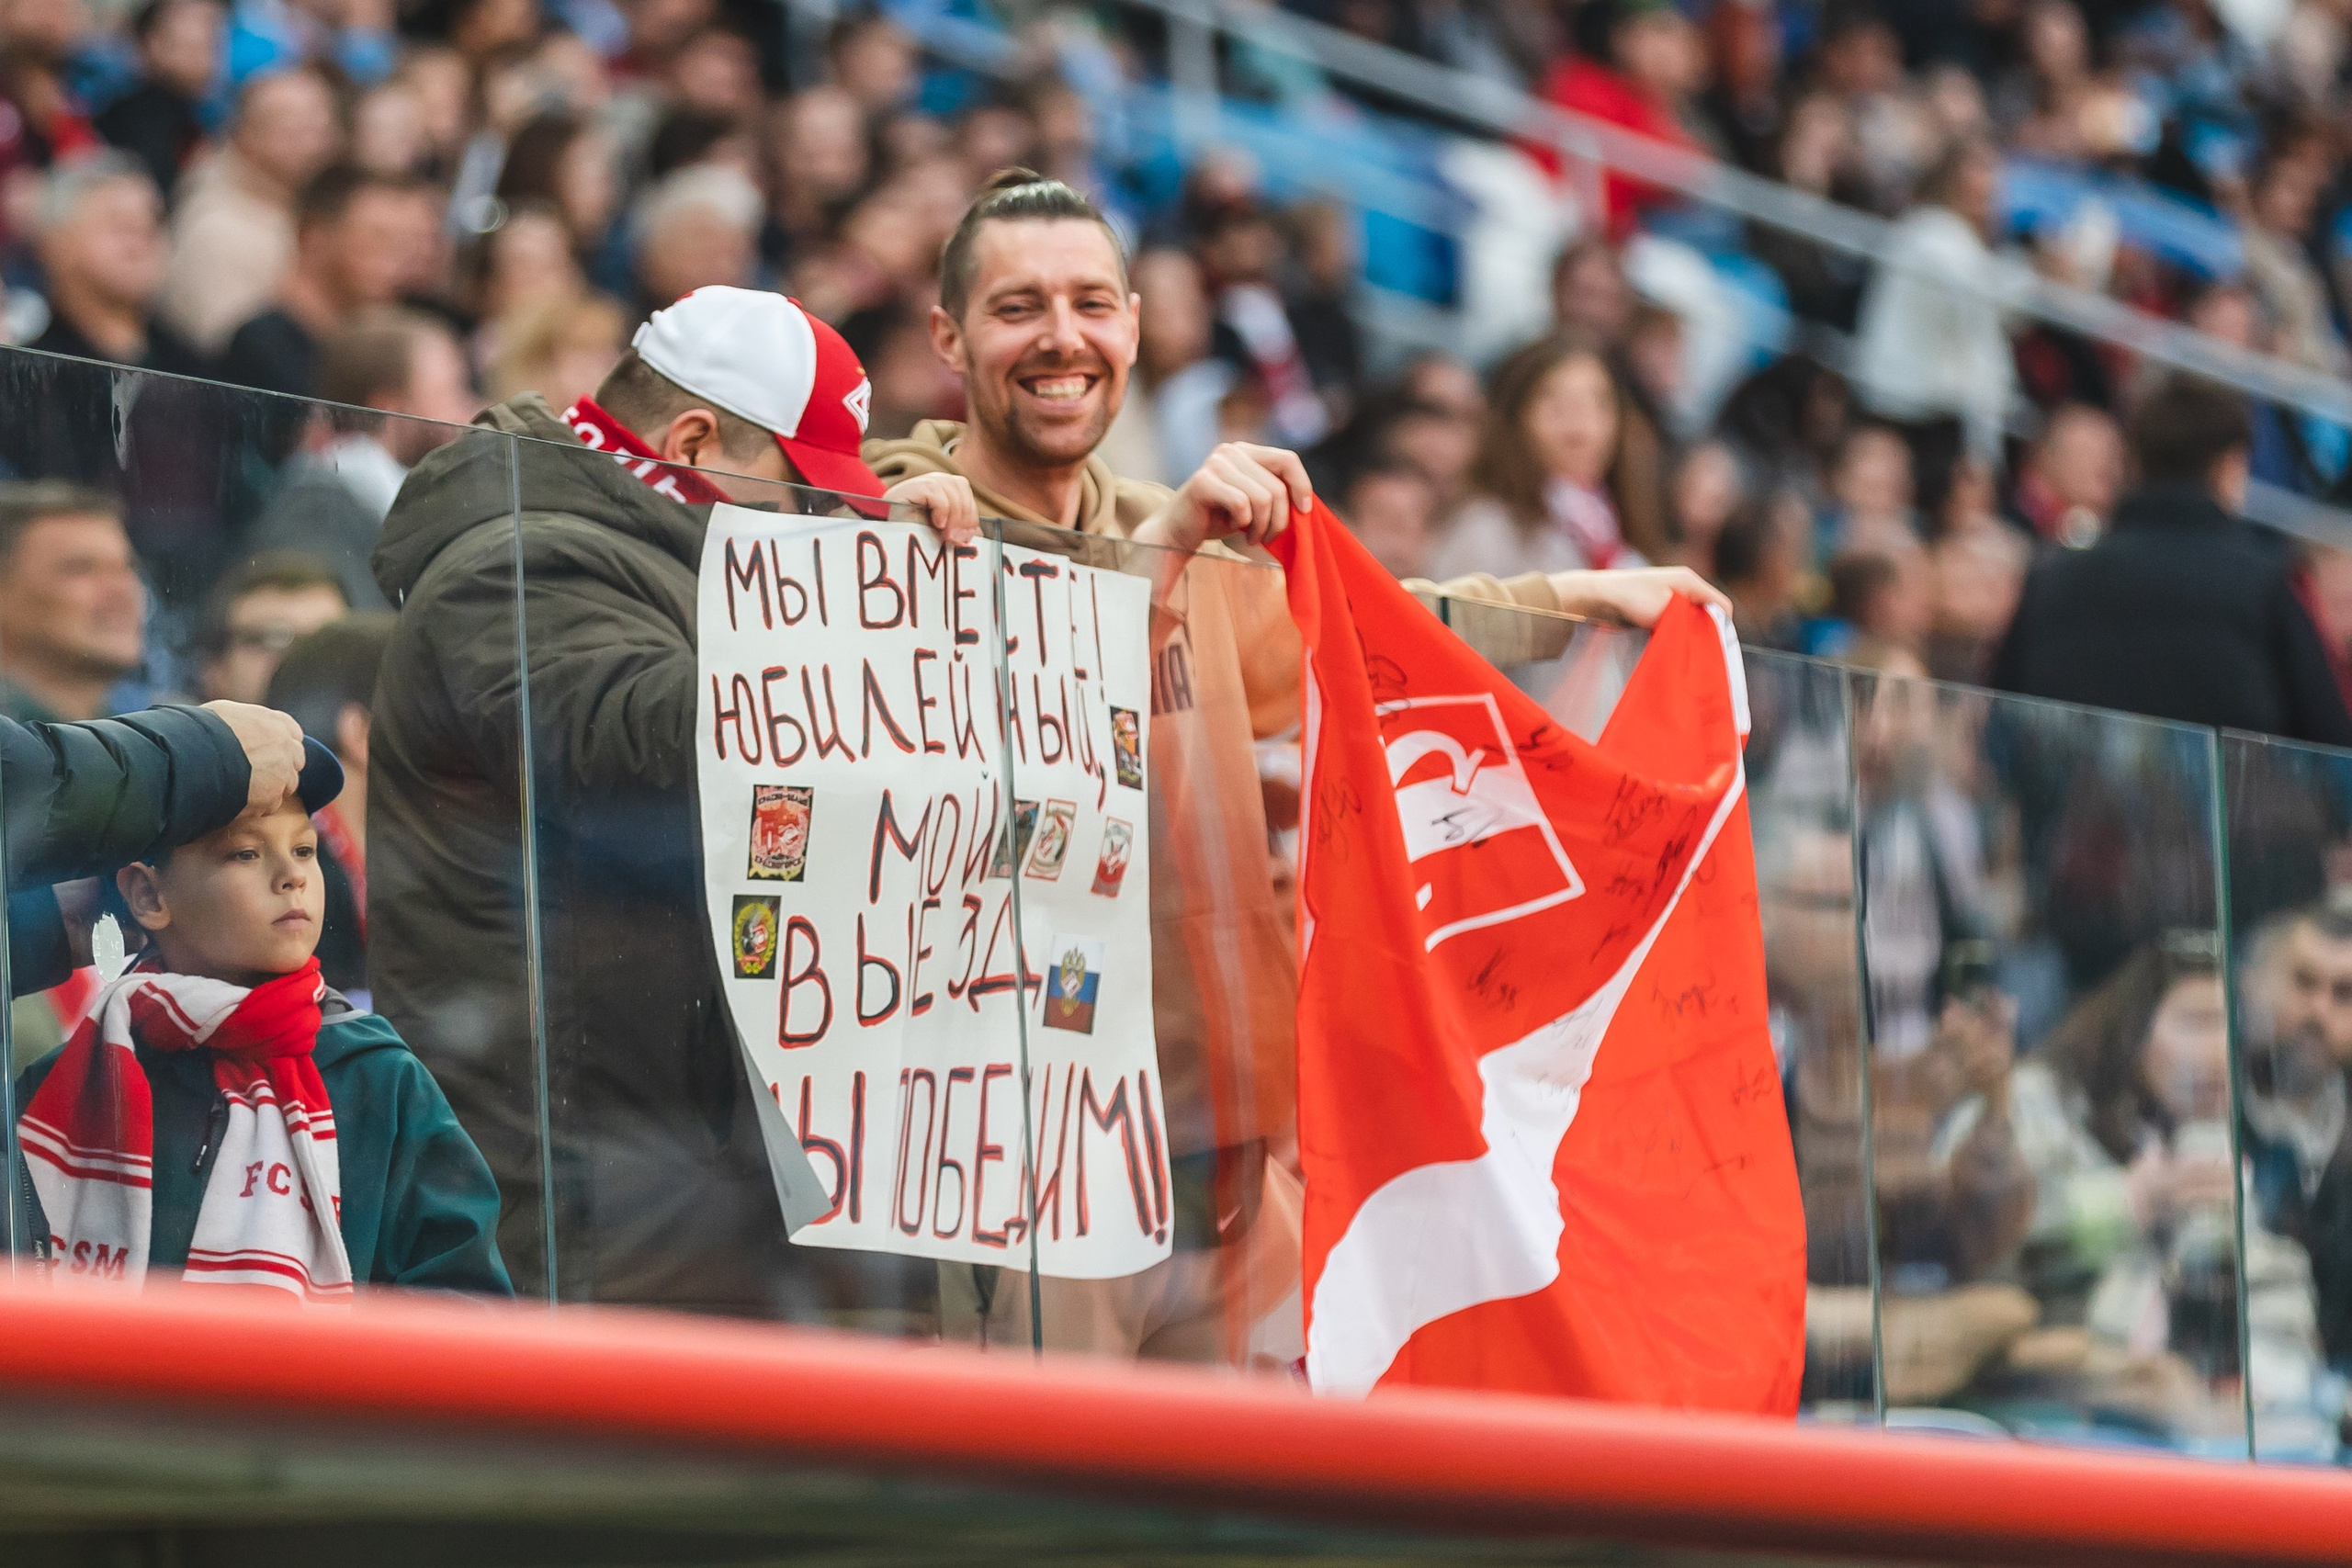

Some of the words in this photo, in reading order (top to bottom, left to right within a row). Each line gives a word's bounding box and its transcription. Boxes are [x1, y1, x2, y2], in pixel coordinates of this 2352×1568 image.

[724, 536, 829, 632] МЫ
[854, 530, 1105, 702] ВМЕСТ!
[868, 770, 1000, 905] МОЙ
[777, 890, 1043, 1050] ВЫЕЗД
[239, 1160, 291, 1197] FC
[770, 1070, 866, 1225] Ы
